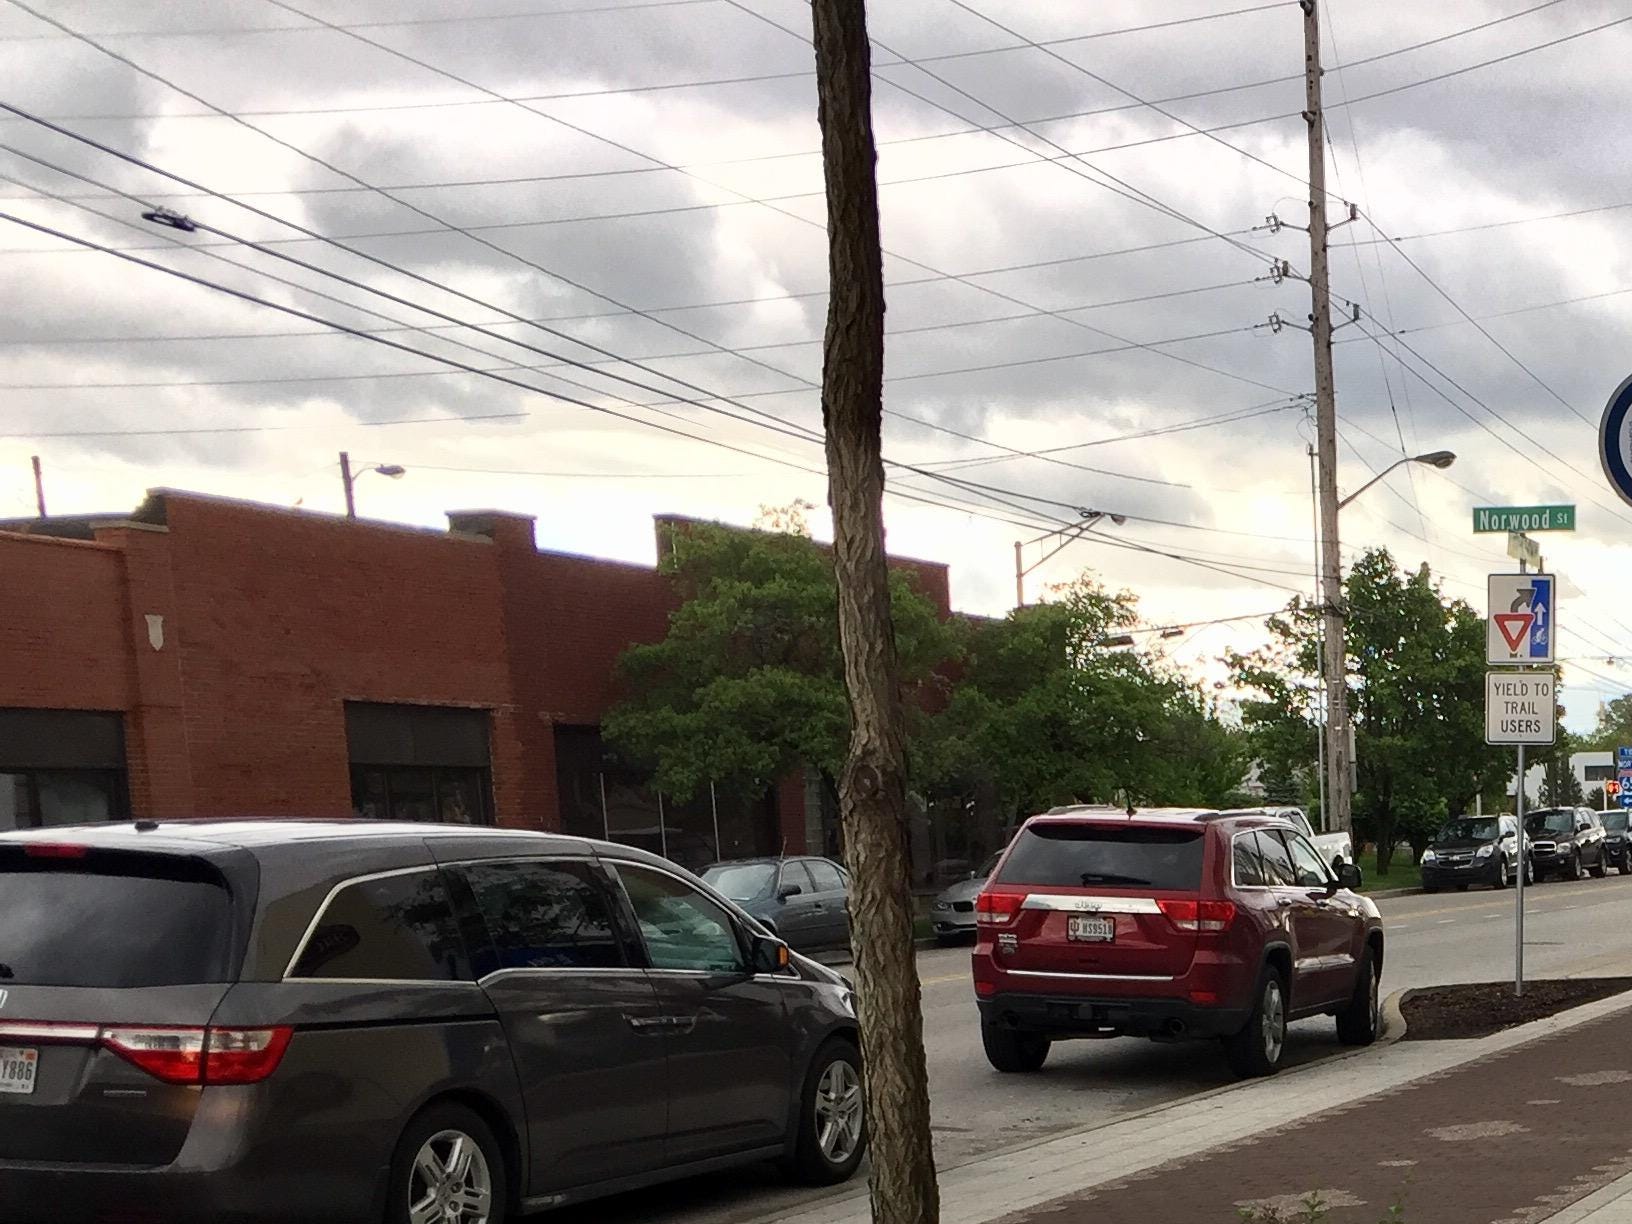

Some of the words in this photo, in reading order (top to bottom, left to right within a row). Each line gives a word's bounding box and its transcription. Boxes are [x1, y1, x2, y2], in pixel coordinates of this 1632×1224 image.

[1479, 510, 1550, 531] Norwood
[1556, 512, 1568, 524] St
[1494, 682, 1529, 697] YIELD
[1534, 682, 1549, 697] TO
[1504, 701, 1539, 716] TRAIL
[1501, 719, 1541, 734] USERS
